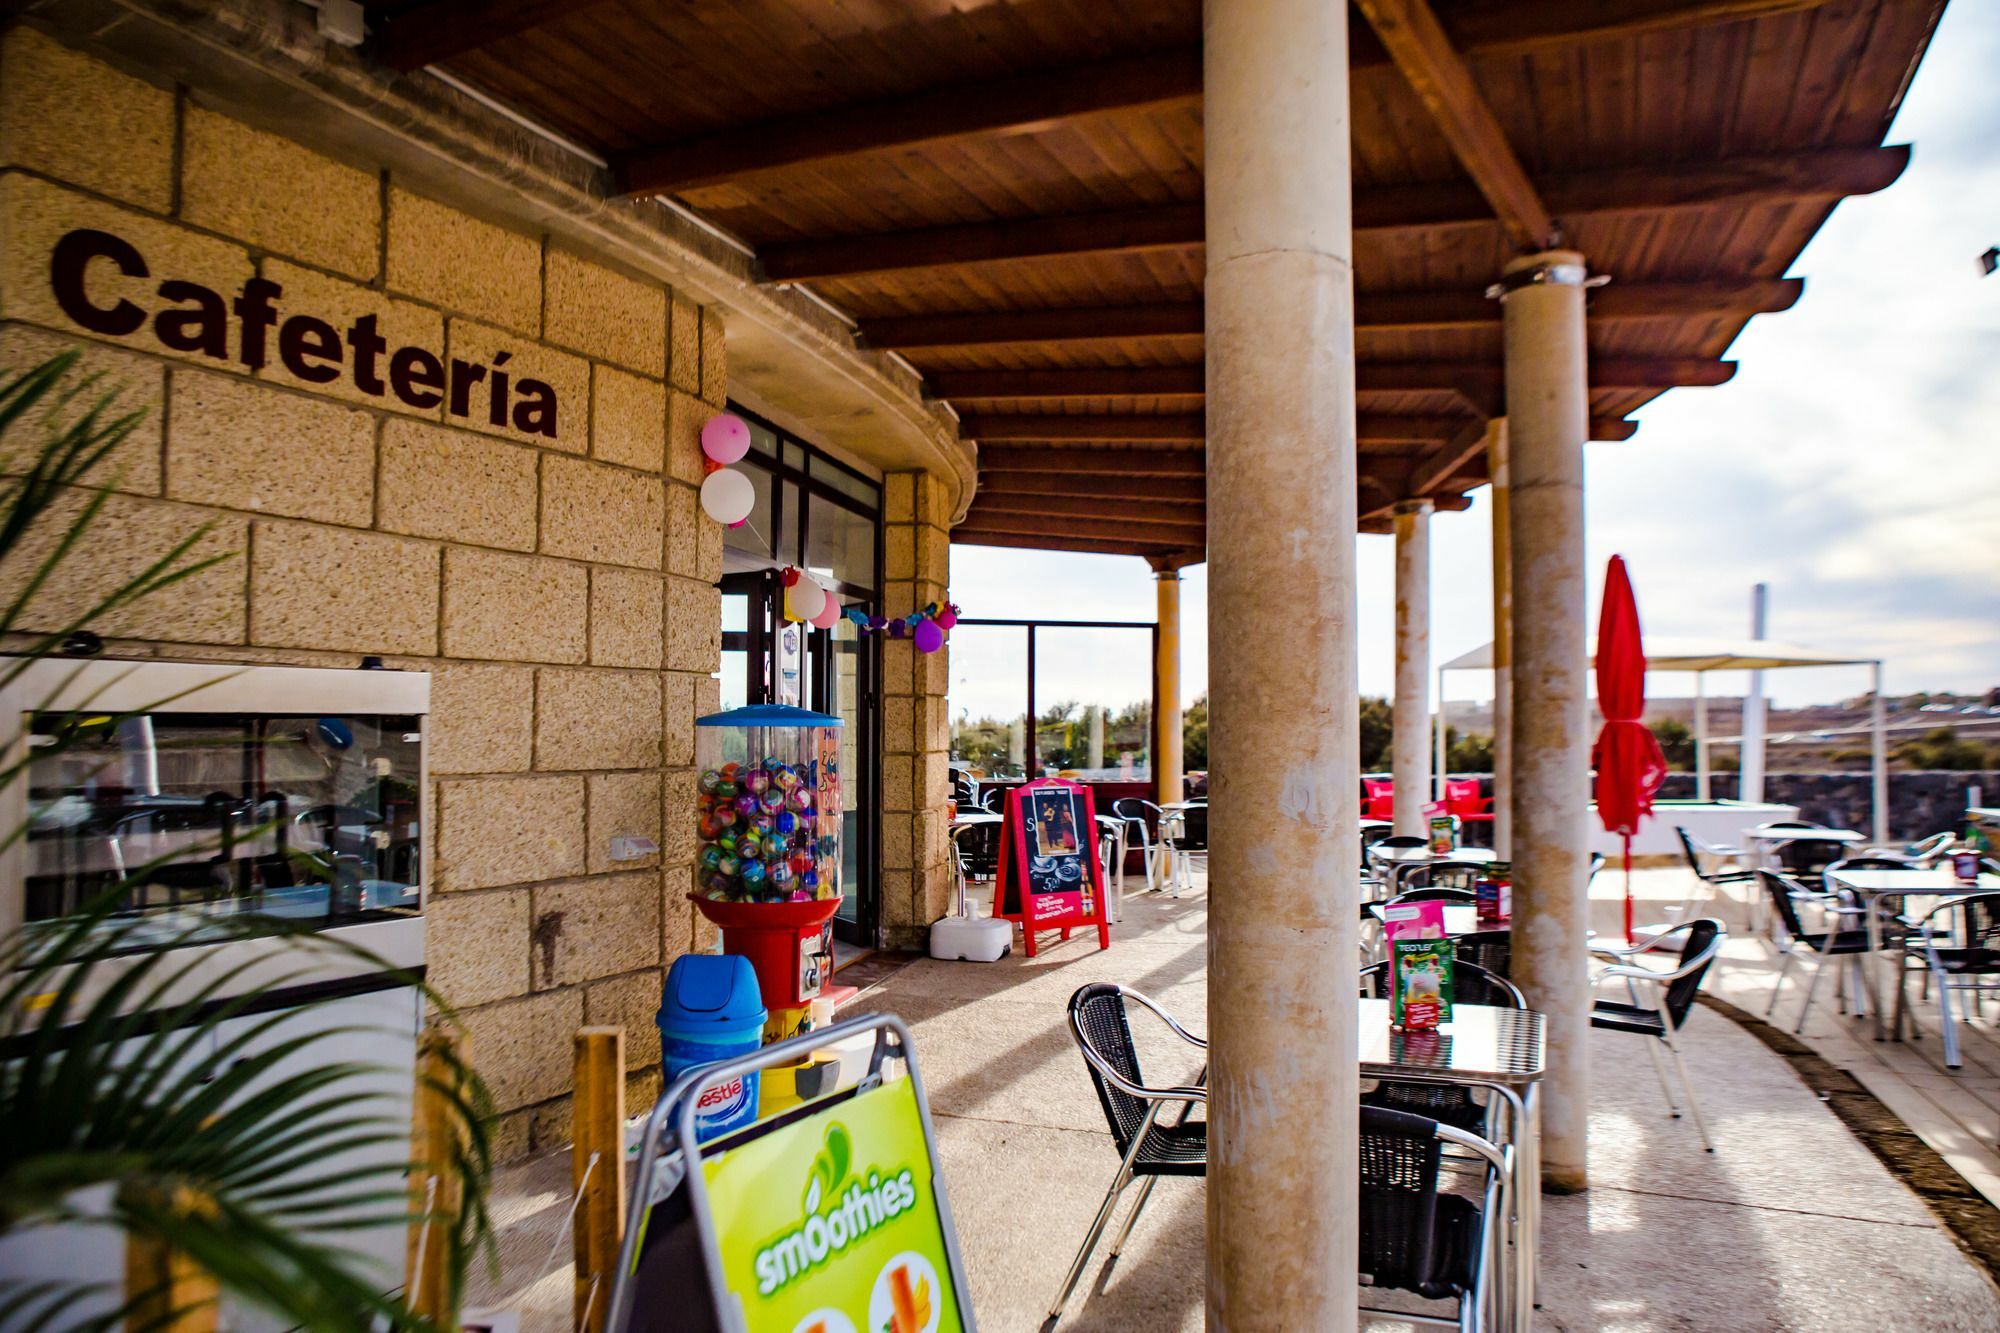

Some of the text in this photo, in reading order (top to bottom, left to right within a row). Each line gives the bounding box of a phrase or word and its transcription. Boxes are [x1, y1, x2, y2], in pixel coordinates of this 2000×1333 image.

[50, 228, 558, 439] Cafetería
[696, 1077, 742, 1109] estlé
[755, 1169, 915, 1295] smoothies
